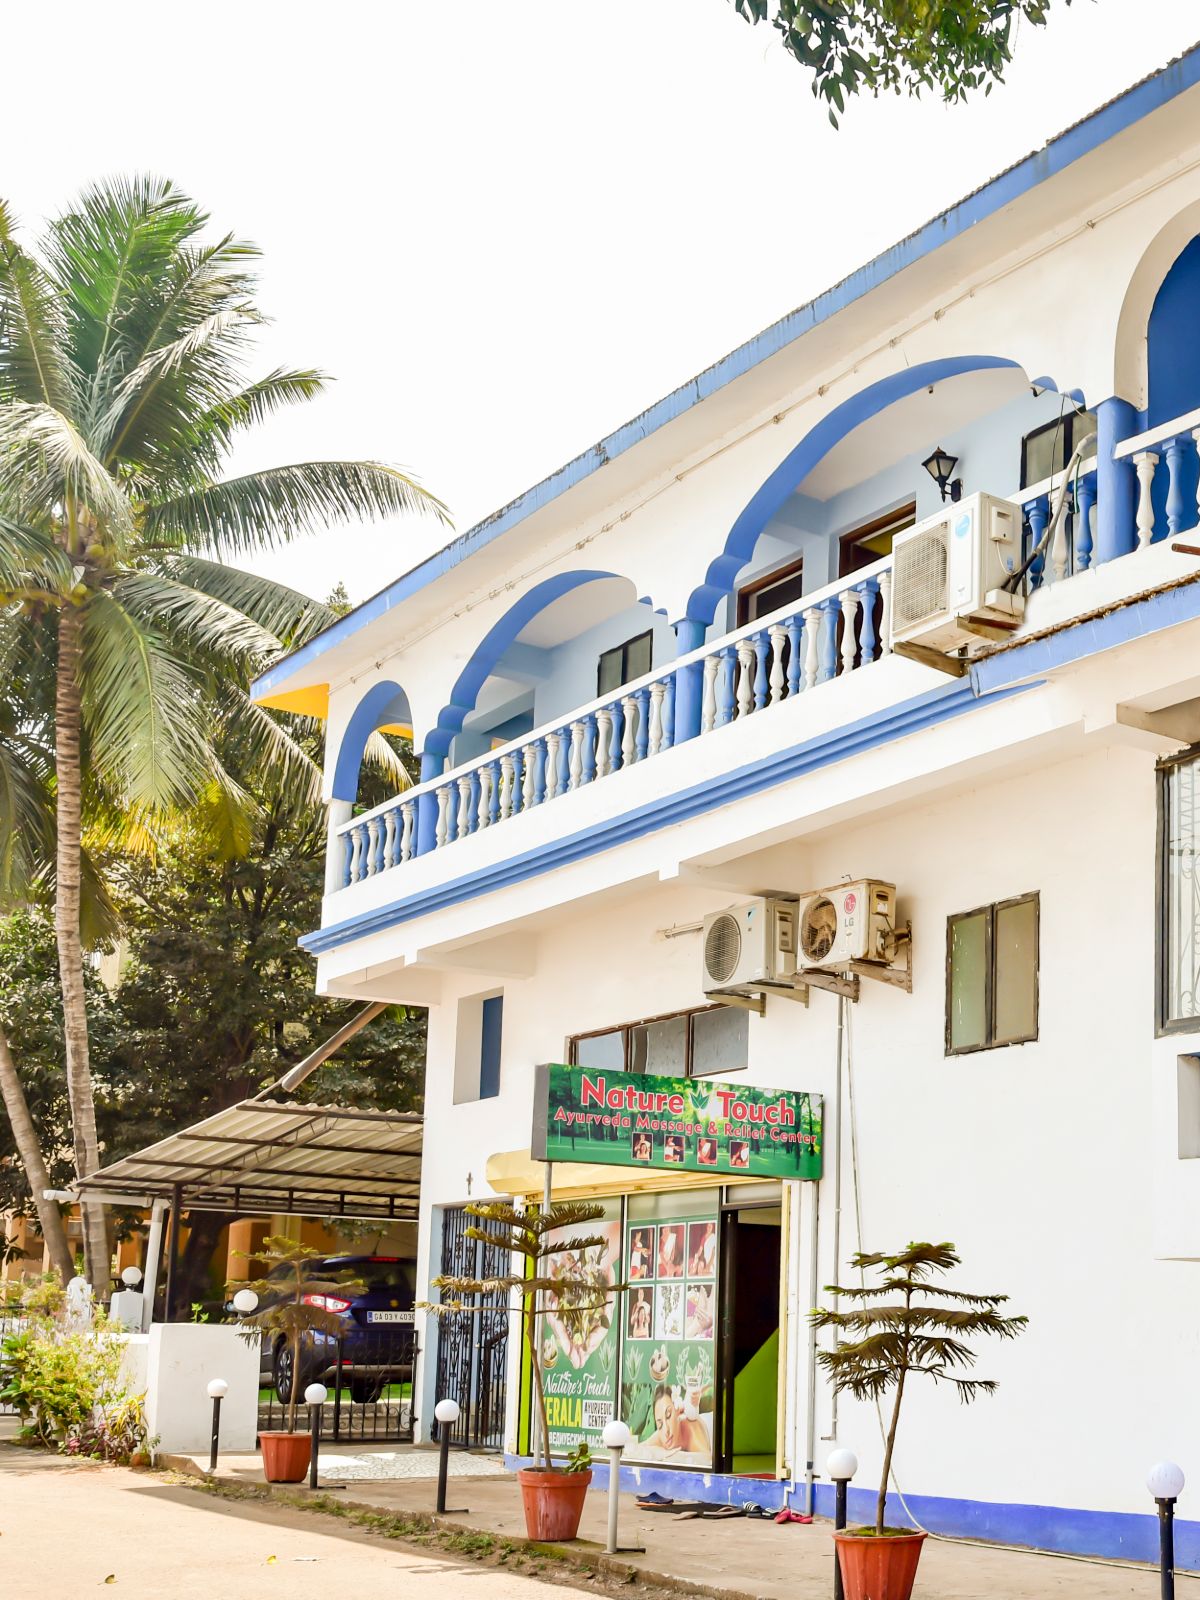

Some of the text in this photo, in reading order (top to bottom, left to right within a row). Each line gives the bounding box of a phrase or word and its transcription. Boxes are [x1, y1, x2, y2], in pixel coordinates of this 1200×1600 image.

[844, 917, 855, 928] LG
[580, 1074, 796, 1126] Nature Touch
[554, 1106, 818, 1145] Ayurveda Massage & Relief Center
[544, 1371, 612, 1396] Nature's Touch
[544, 1396, 583, 1428] ERALA
[584, 1402, 612, 1415] AYURVEDIC
[548, 1431, 586, 1447] ВЕДИЧЕСКИЙ
